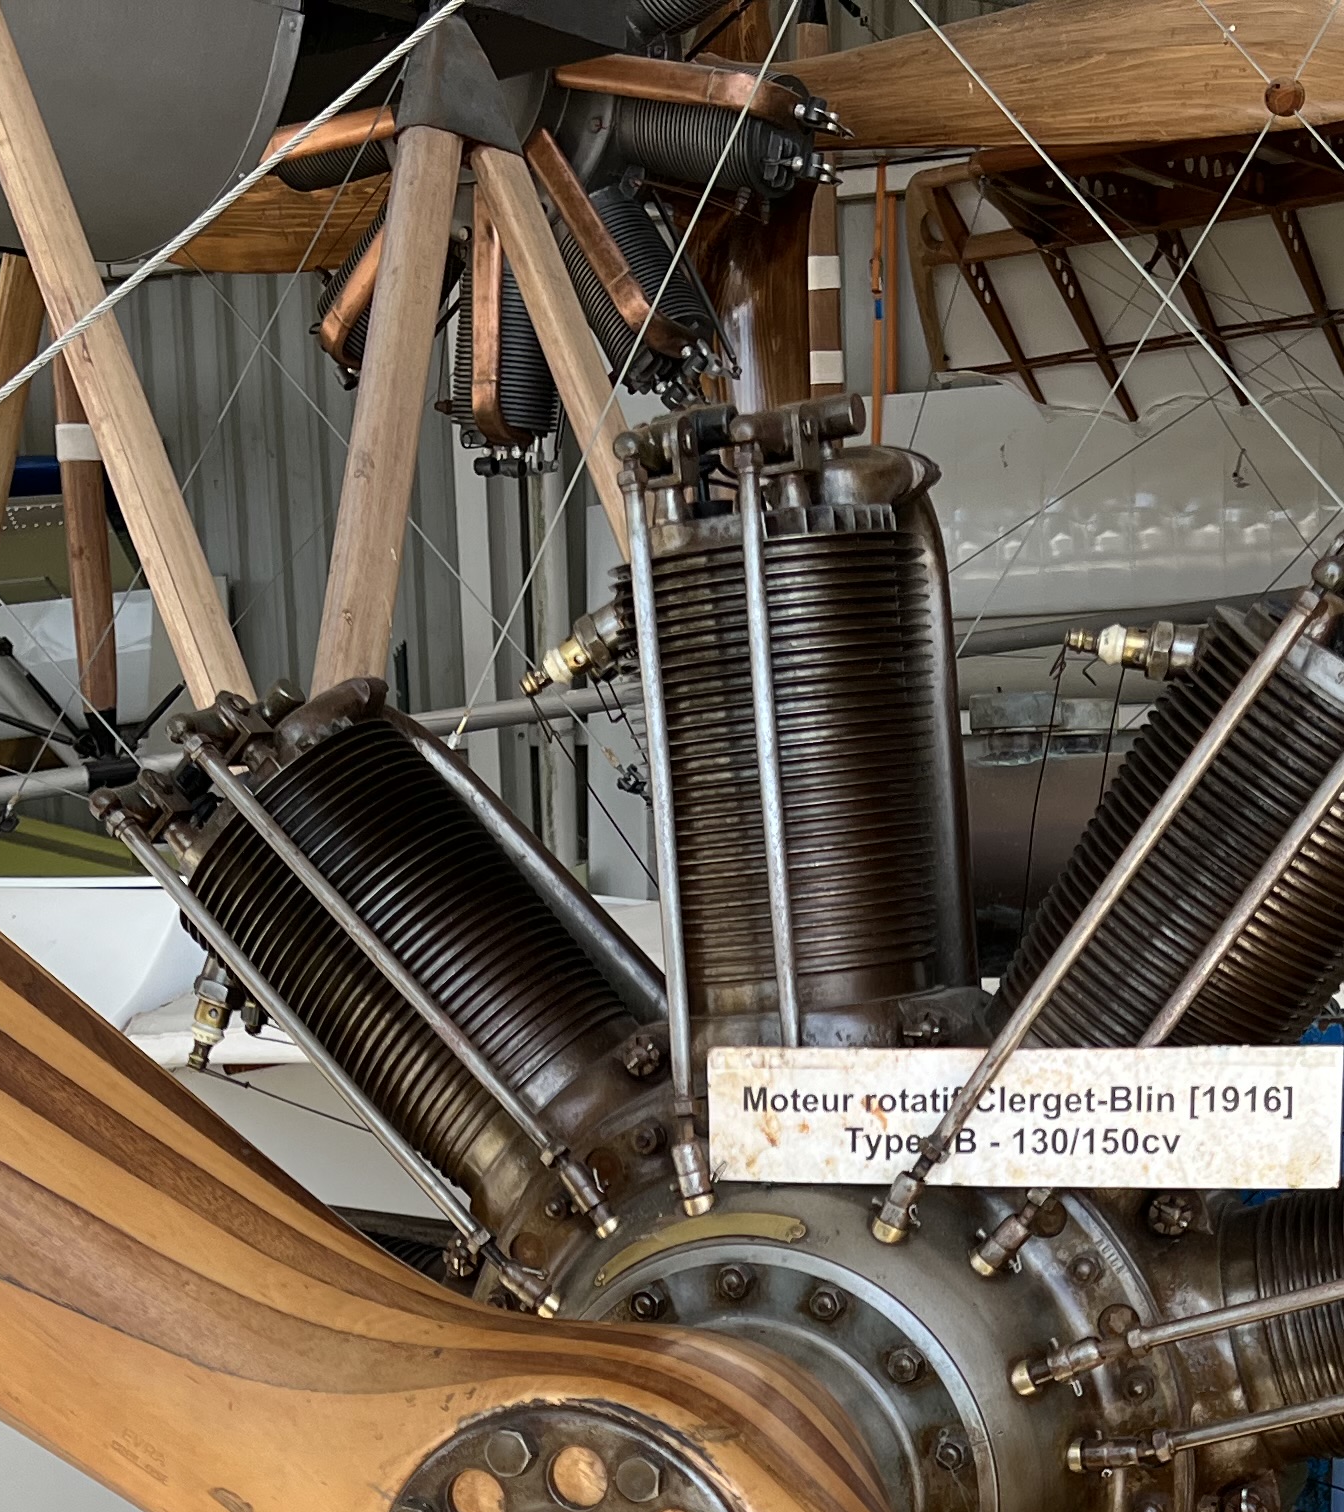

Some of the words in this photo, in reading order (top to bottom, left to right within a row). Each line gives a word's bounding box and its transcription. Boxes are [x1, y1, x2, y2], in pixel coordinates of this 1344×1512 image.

[742, 1086, 853, 1112] Moteur
[1190, 1086, 1293, 1119] [1916]
[845, 1127, 922, 1161] Type
[944, 1128, 977, 1154] B
[1012, 1128, 1181, 1154] 130/150cv
